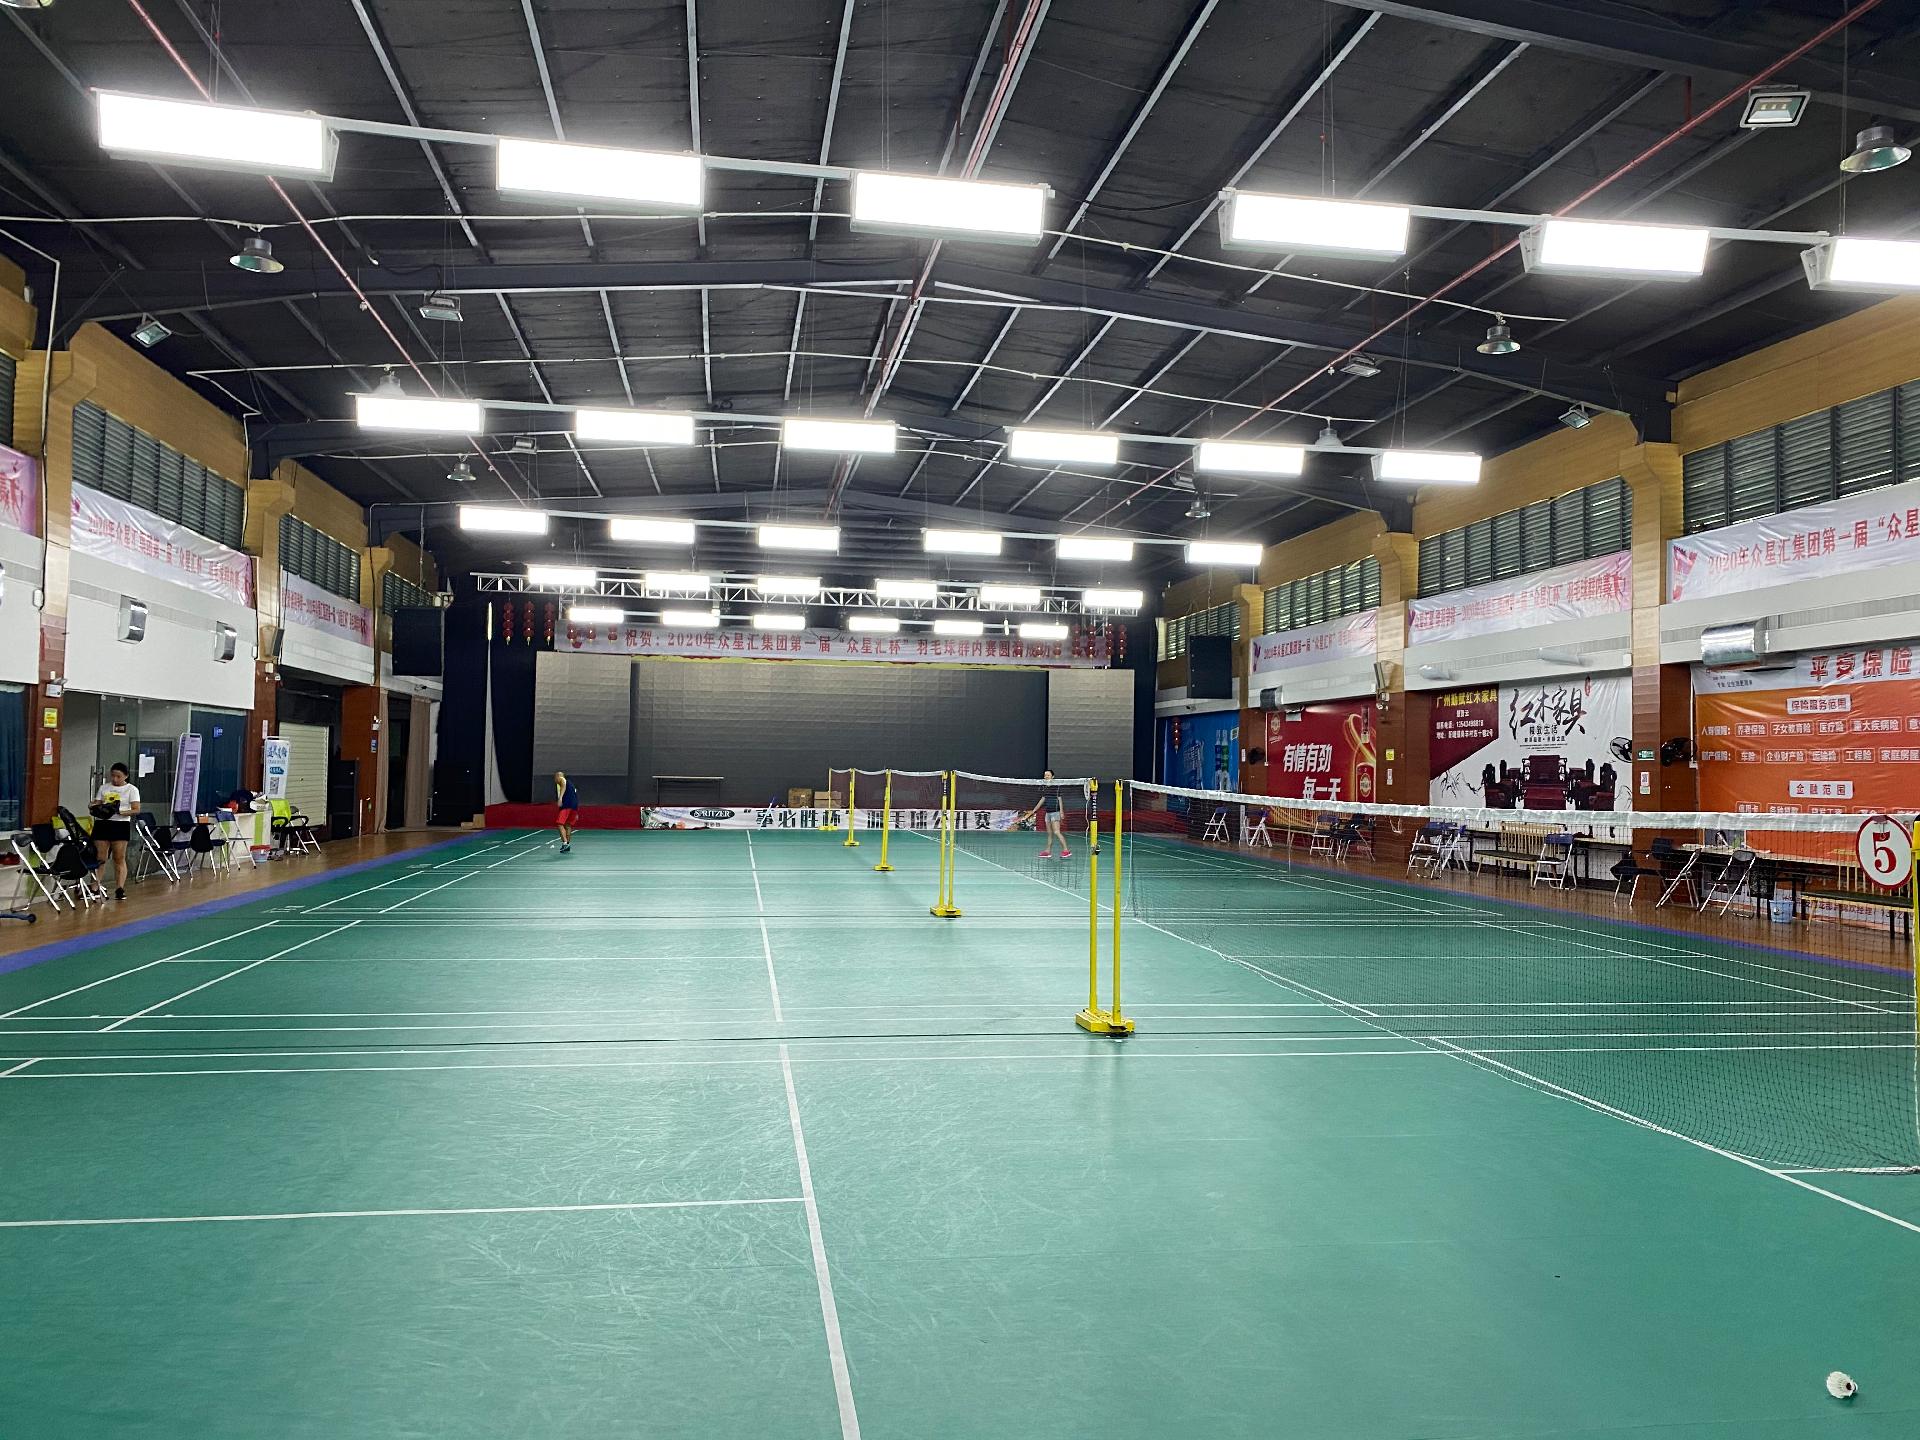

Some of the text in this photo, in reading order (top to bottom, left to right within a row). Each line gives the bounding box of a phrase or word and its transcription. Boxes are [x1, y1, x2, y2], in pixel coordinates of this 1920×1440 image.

[1810, 646, 1912, 681] 平安保险
[1509, 686, 1587, 740] 红木家具
[1791, 698, 1846, 711] 保险服务范围
[1737, 724, 1766, 735] 养老保险
[1772, 722, 1811, 734] 子女教育险
[1819, 720, 1844, 733] 医疗险
[1853, 719, 1899, 731] 重大疾病险
[1283, 743, 1333, 772] 有情有劲
[1741, 751, 1756, 762] 车险
[1766, 751, 1804, 762] 企业财产险
[1845, 750, 1872, 761] 工程险
[1303, 777, 1341, 801] 每一天
[1796, 783, 1846, 796] 金融范围
[1873, 831, 1897, 874] 5
